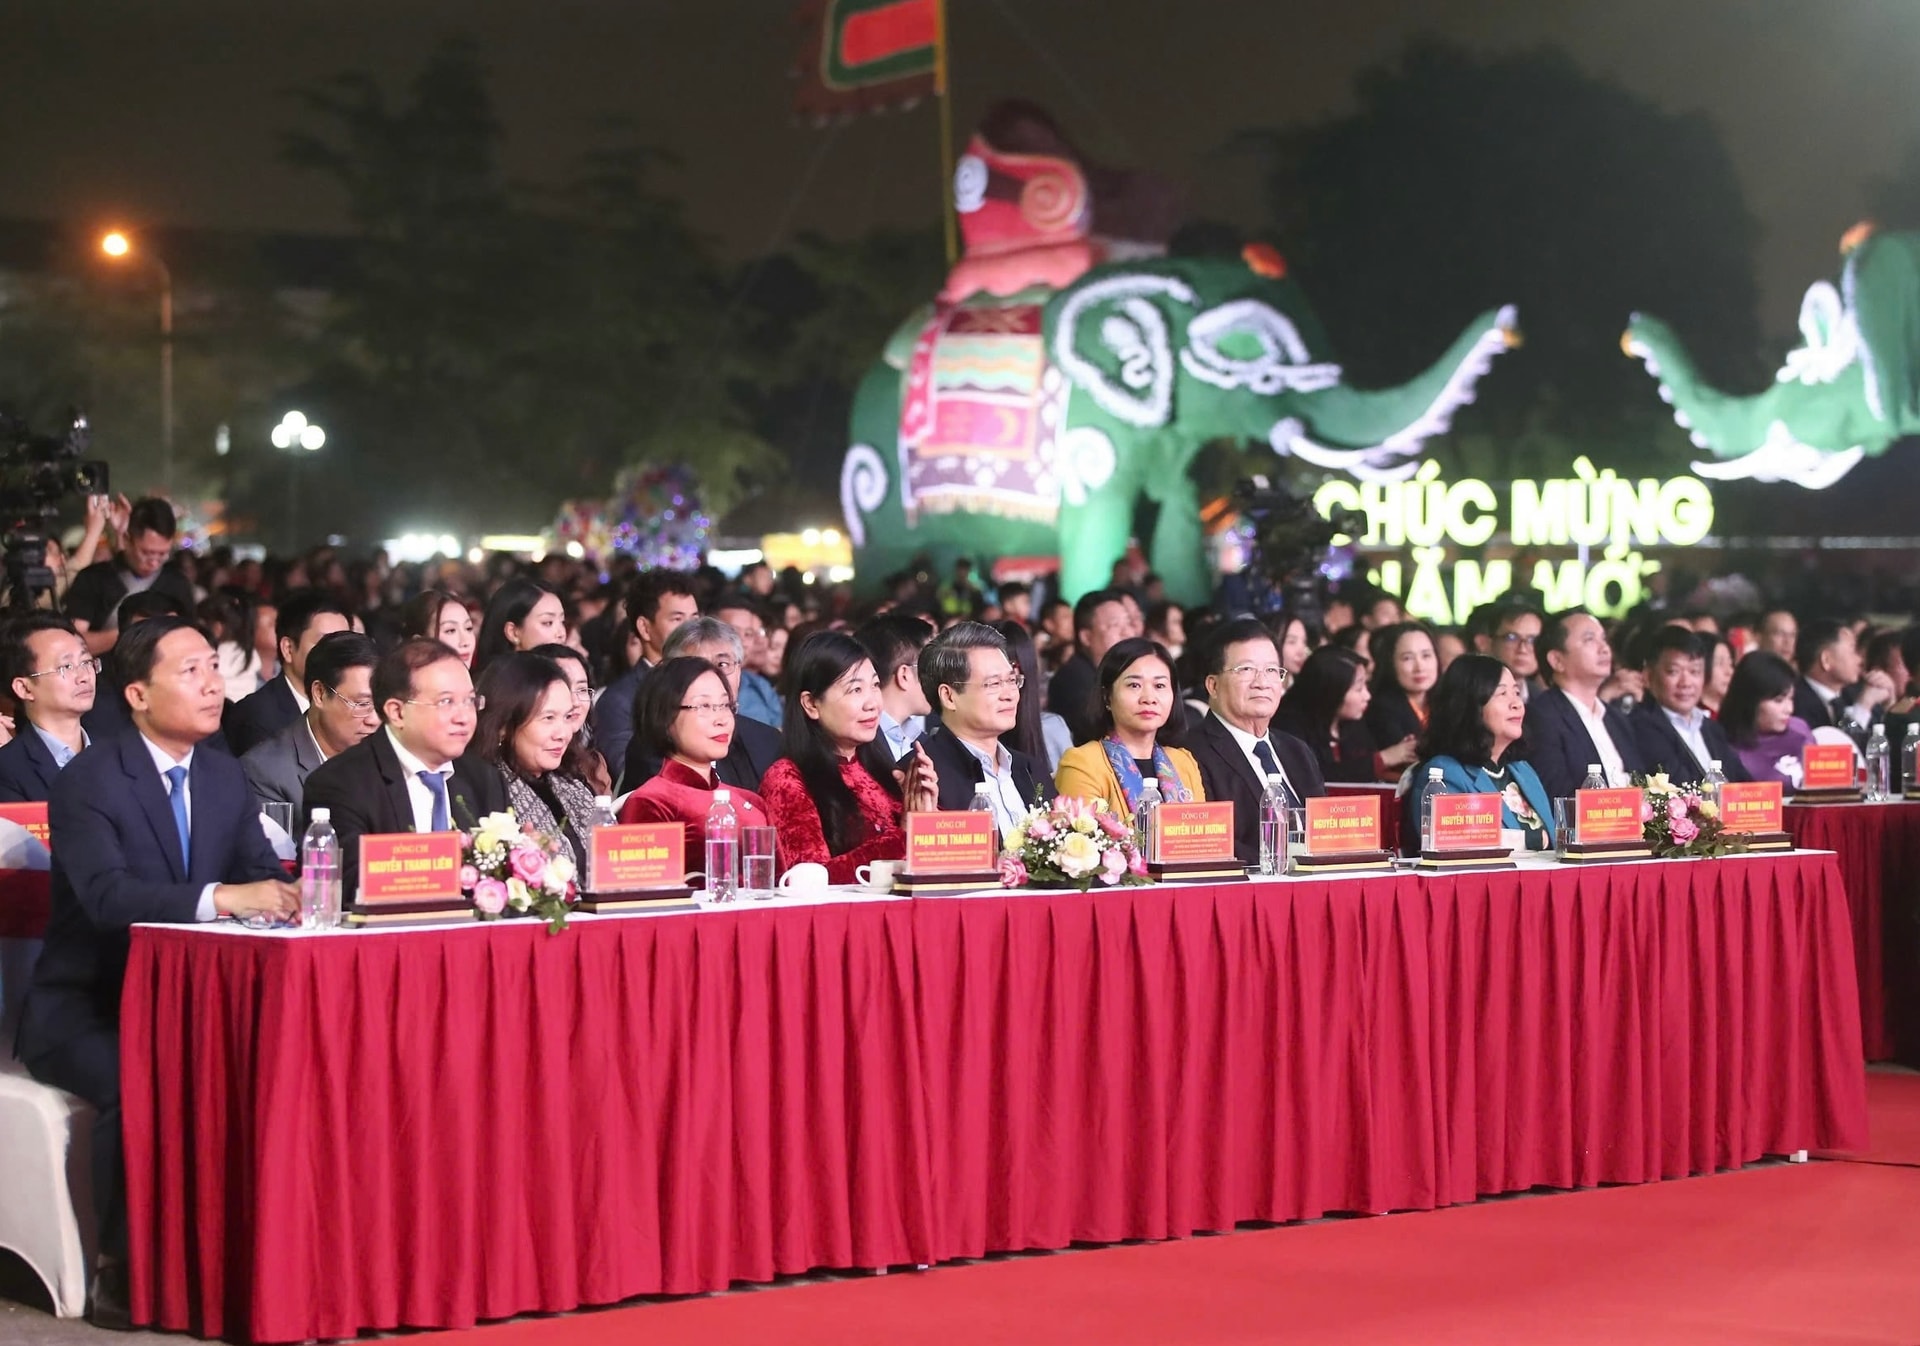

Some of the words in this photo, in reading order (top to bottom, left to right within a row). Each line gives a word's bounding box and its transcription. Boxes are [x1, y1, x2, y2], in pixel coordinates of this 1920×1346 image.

[1511, 455, 1715, 547] MỪNG
[1339, 817, 1359, 828] QUANG
[1441, 812, 1464, 826] NGUYỄN
[1191, 824, 1204, 835] LAN
[914, 834, 935, 848] PHẠM
[949, 833, 972, 845] THANH
[973, 833, 988, 844] MAI
